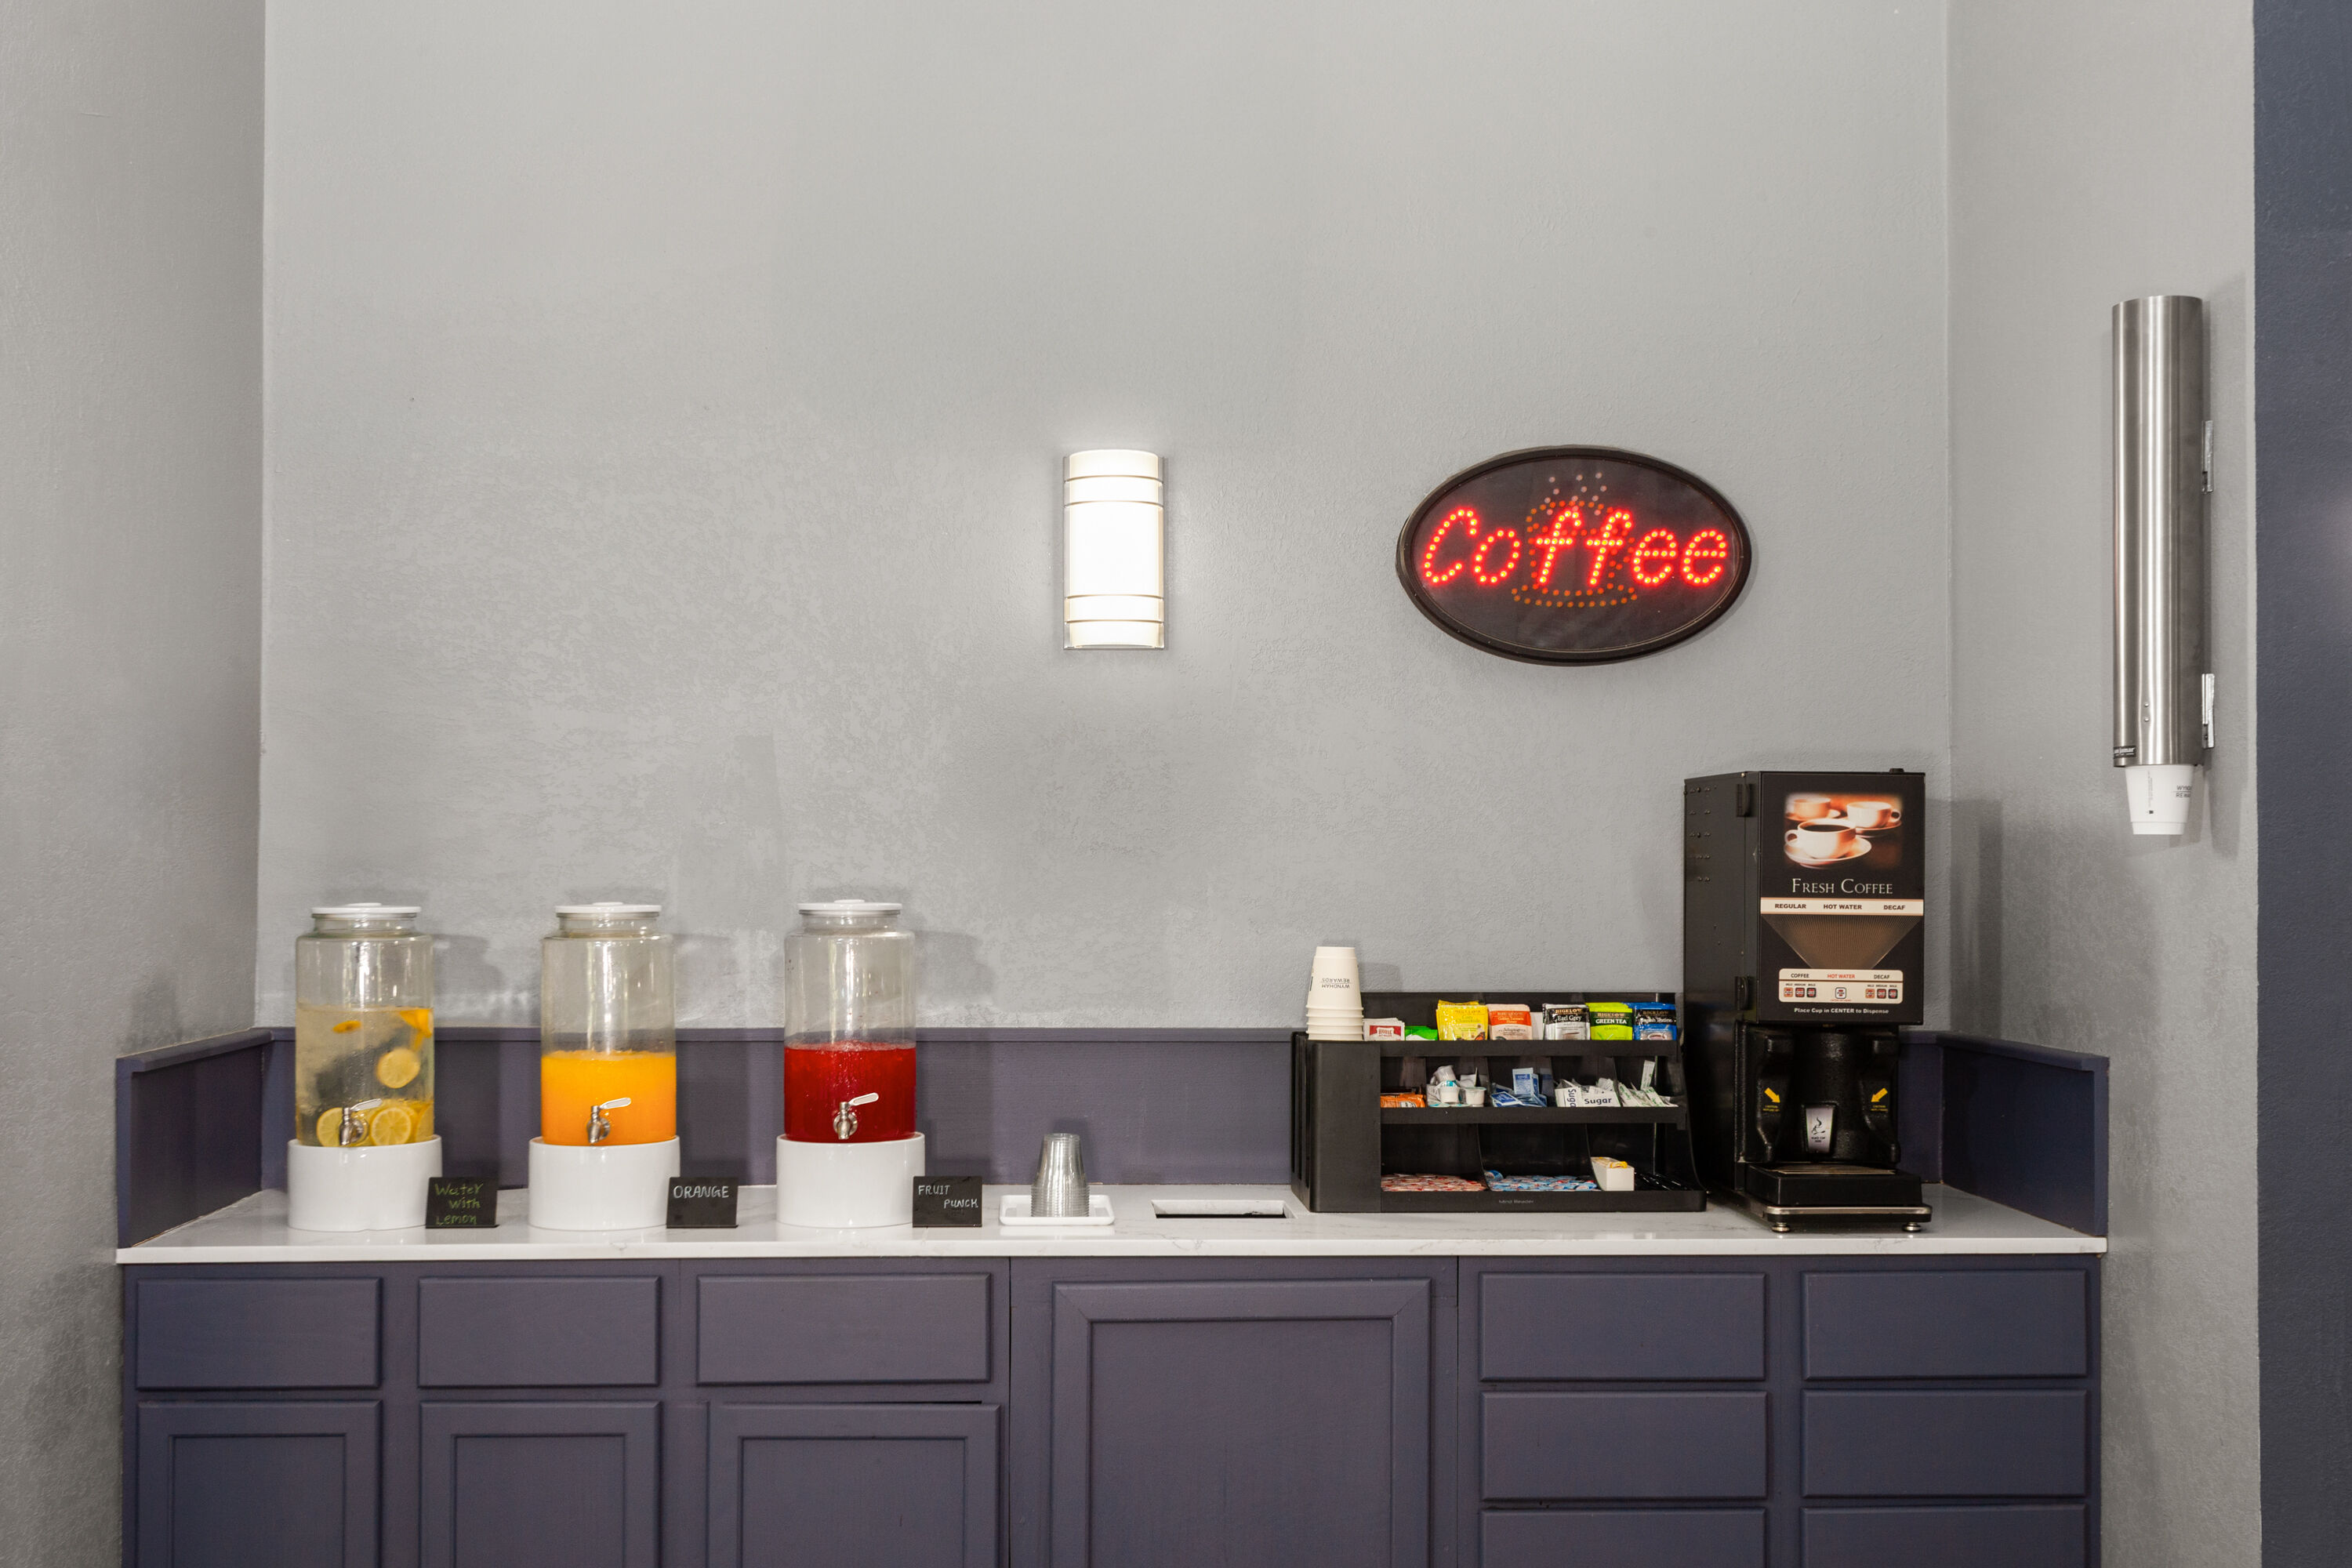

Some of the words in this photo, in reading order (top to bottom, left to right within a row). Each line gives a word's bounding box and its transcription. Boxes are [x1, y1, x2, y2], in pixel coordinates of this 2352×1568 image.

[1423, 507, 1729, 586] Coffee
[1792, 878, 1835, 893] FRESH
[1841, 878, 1893, 894] COFFEE
[434, 1183, 483, 1196] Water
[673, 1185, 729, 1199] ORANGE
[918, 1185, 951, 1196] FRUIT
[943, 1199, 979, 1209] PUNCH
